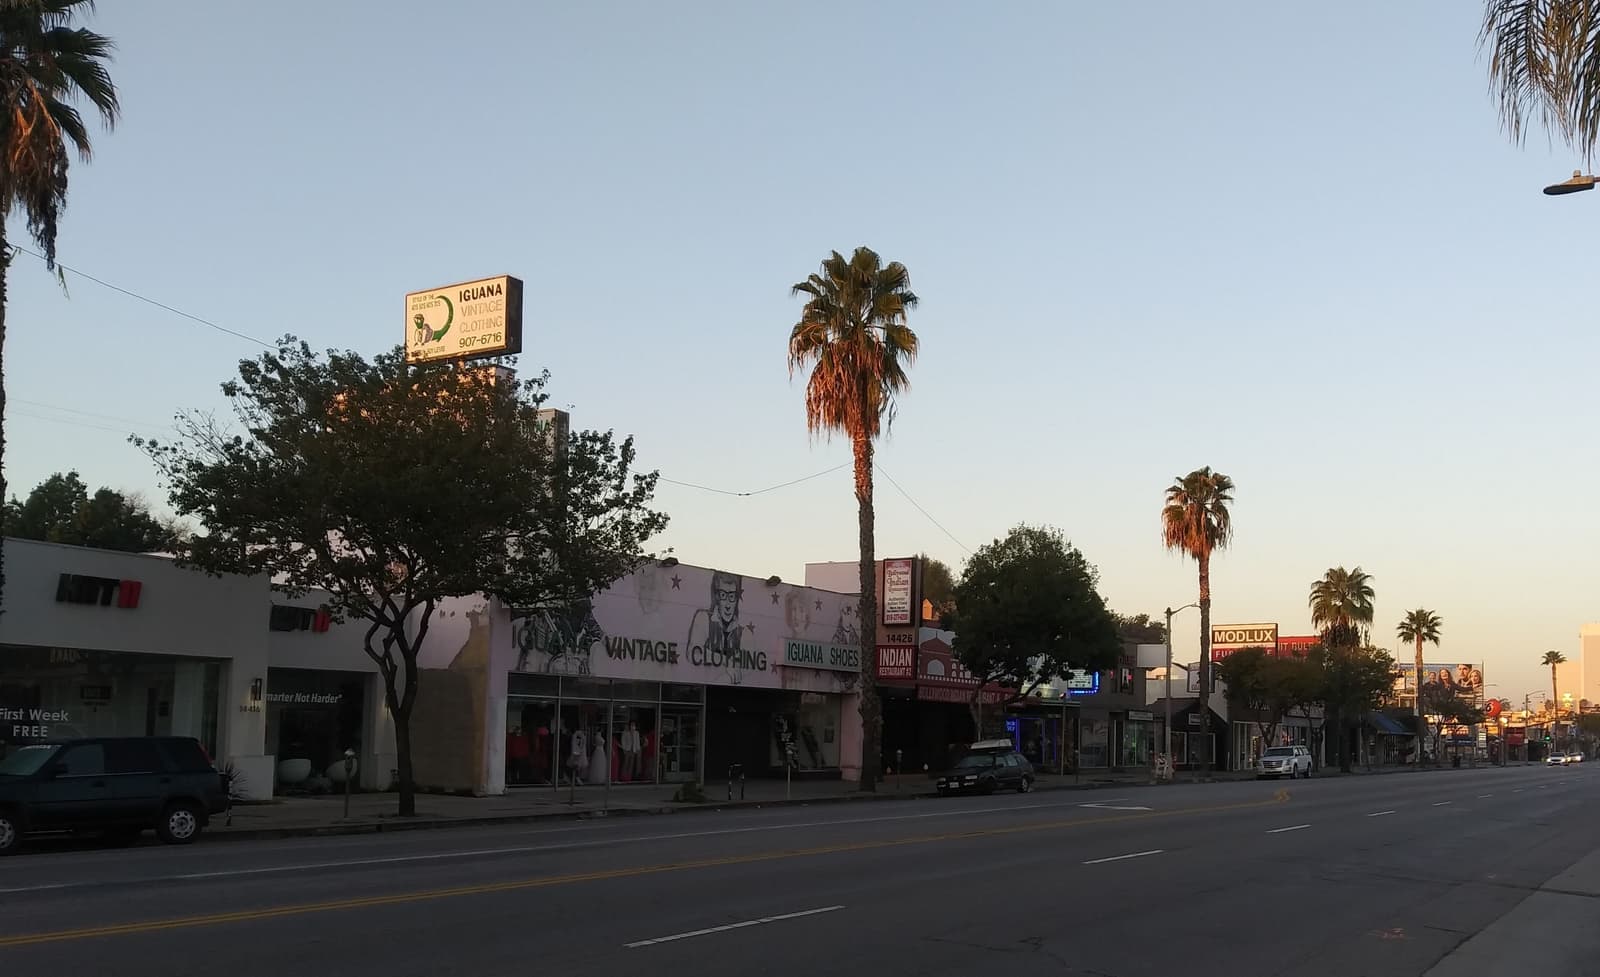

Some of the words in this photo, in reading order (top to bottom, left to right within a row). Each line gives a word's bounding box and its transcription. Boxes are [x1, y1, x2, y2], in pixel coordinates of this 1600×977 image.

[459, 283, 503, 303] IGUANA
[461, 299, 502, 317] VINTAGE
[459, 316, 502, 333] CLOTHING
[459, 332, 502, 348] 907-6716
[1214, 630, 1273, 643] MODLUX
[604, 635, 678, 664] VINTAGE
[691, 645, 767, 671] CLOTHING
[788, 642, 823, 664] IGUANA
[830, 647, 859, 667] SHOES
[879, 647, 912, 667] INDIAN
[265, 692, 293, 702] marter
[295, 692, 310, 702] Not
[28, 708, 69, 721] Week
[12, 725, 48, 737] FREE
